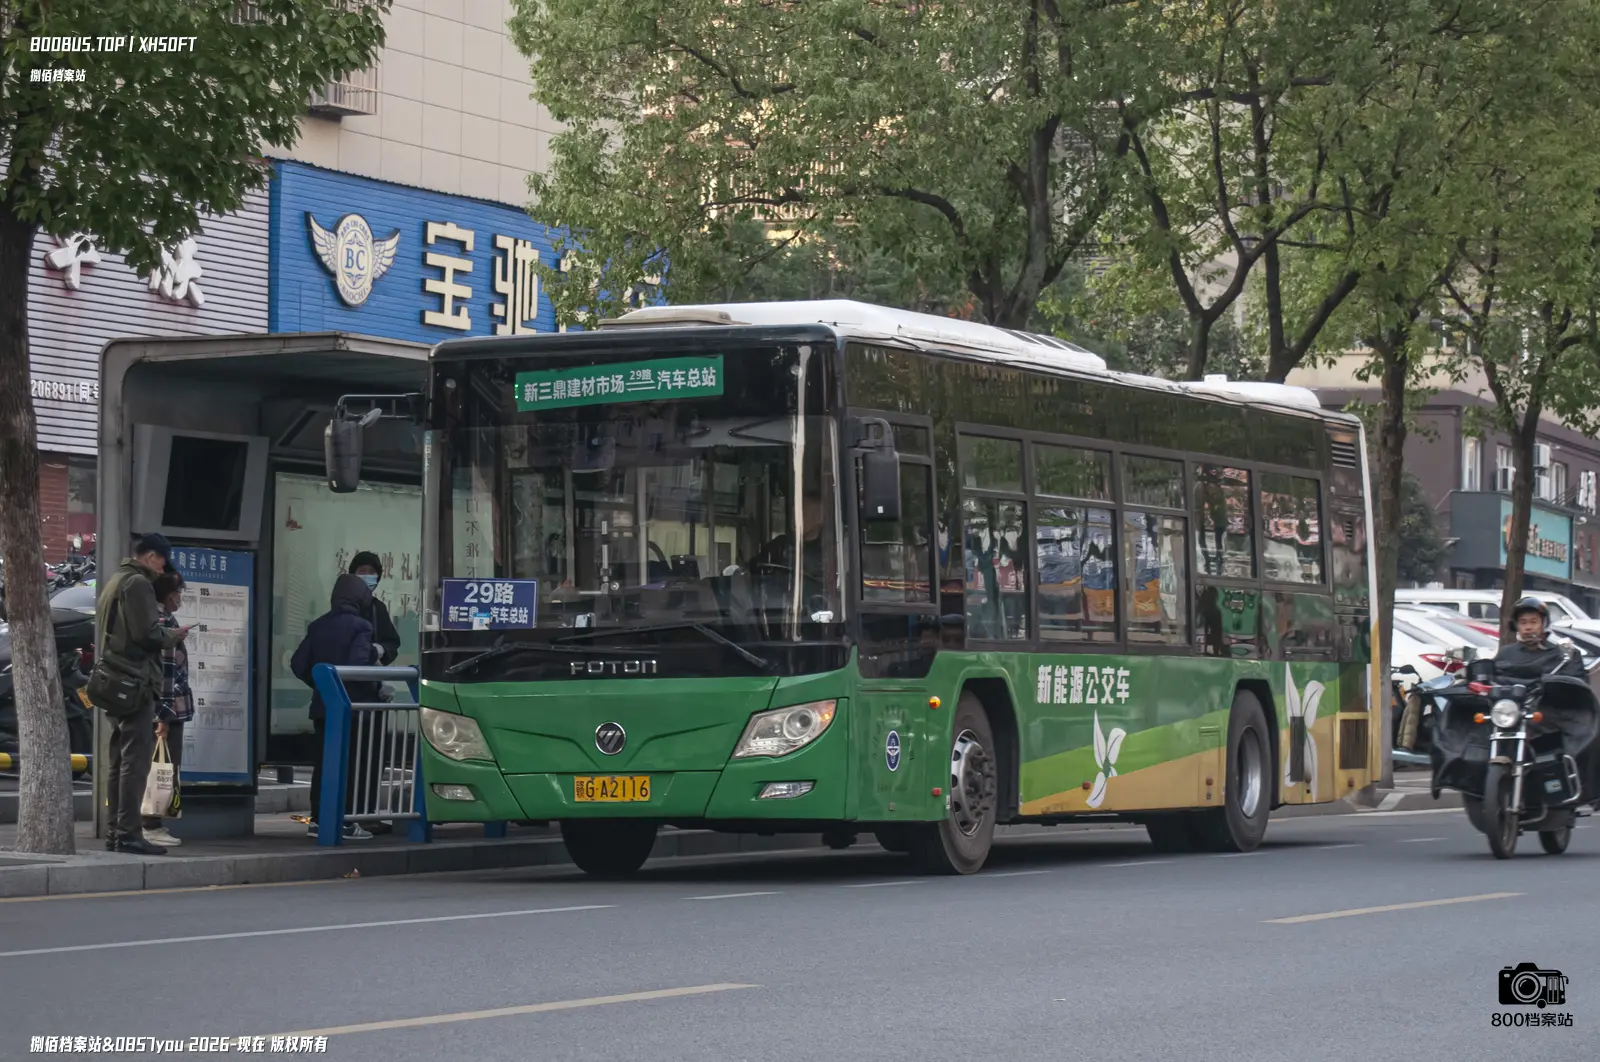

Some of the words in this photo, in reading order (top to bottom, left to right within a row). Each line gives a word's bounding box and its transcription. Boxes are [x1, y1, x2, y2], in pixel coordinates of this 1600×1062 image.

[344, 247, 366, 271] BC
[524, 374, 625, 402] 新三鼎建材市场
[657, 366, 716, 390] 汽车总站
[629, 368, 652, 380] 29路
[464, 582, 514, 605] 29路
[489, 606, 529, 624] 汽车总站
[569, 660, 657, 675] FOTON
[1036, 664, 1131, 704] 新能源公交车
